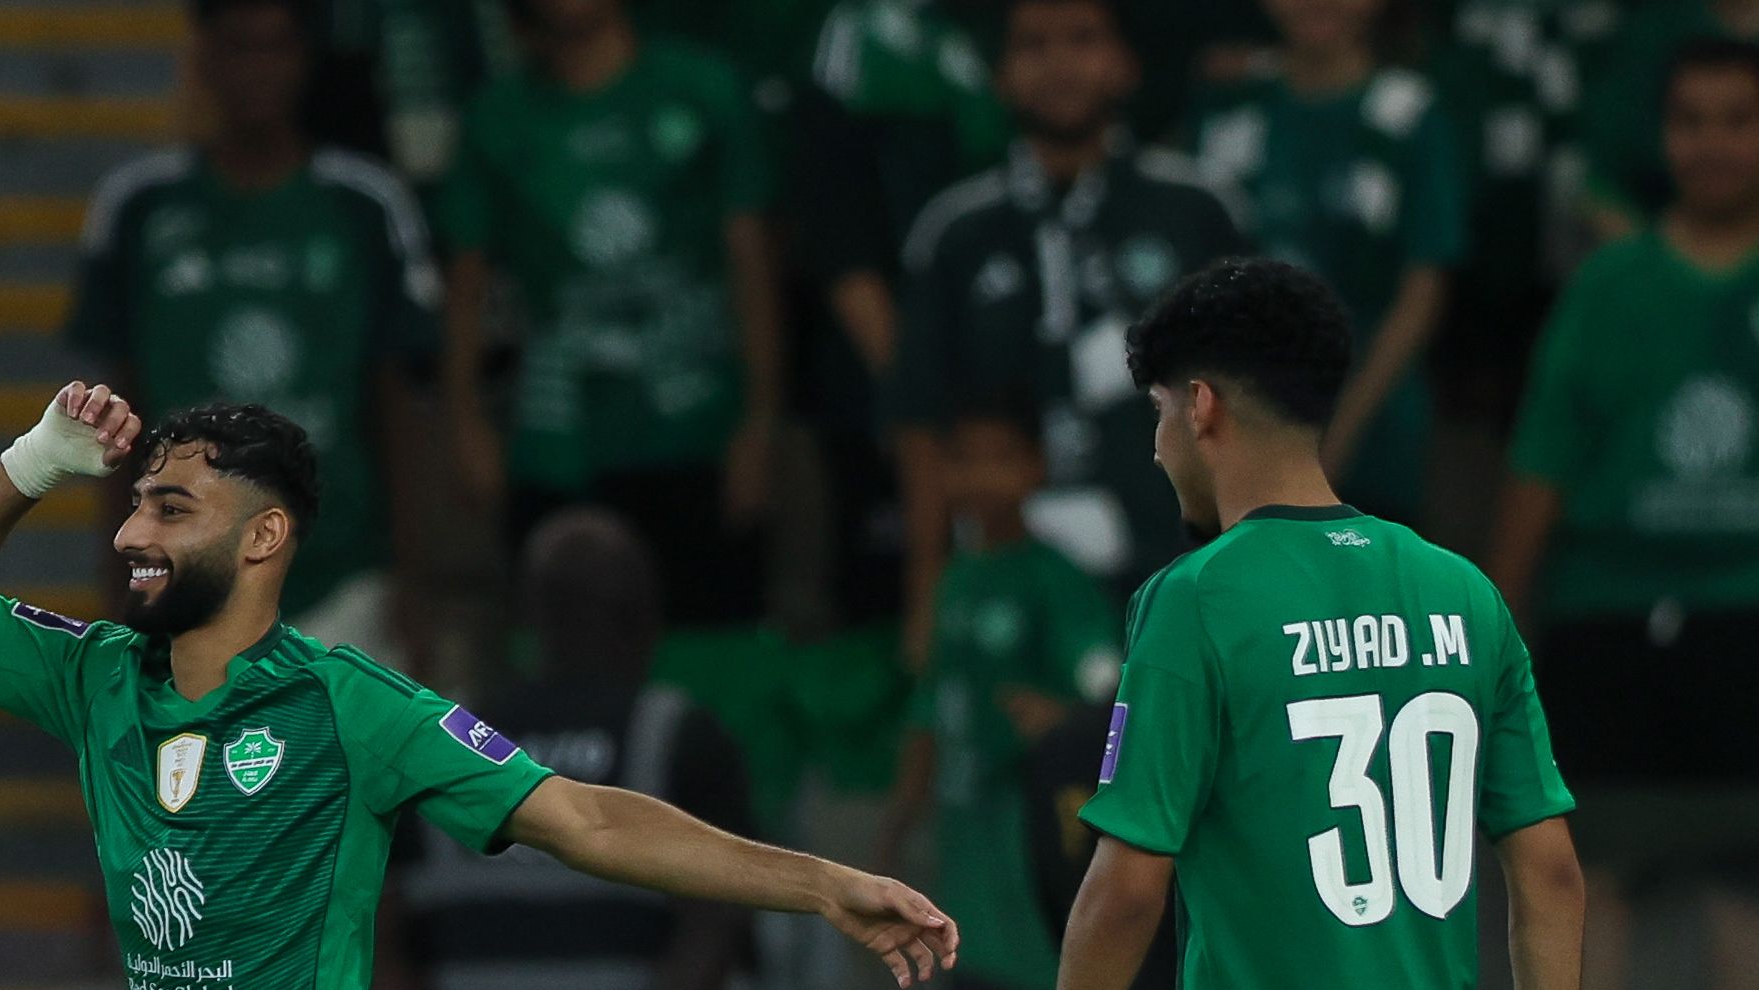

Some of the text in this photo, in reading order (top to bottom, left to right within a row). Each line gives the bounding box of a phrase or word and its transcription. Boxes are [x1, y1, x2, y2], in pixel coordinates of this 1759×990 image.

[1283, 614, 1408, 675] ZIYAD
[1286, 691, 1479, 926] 30
[196, 959, 232, 982] البحر
